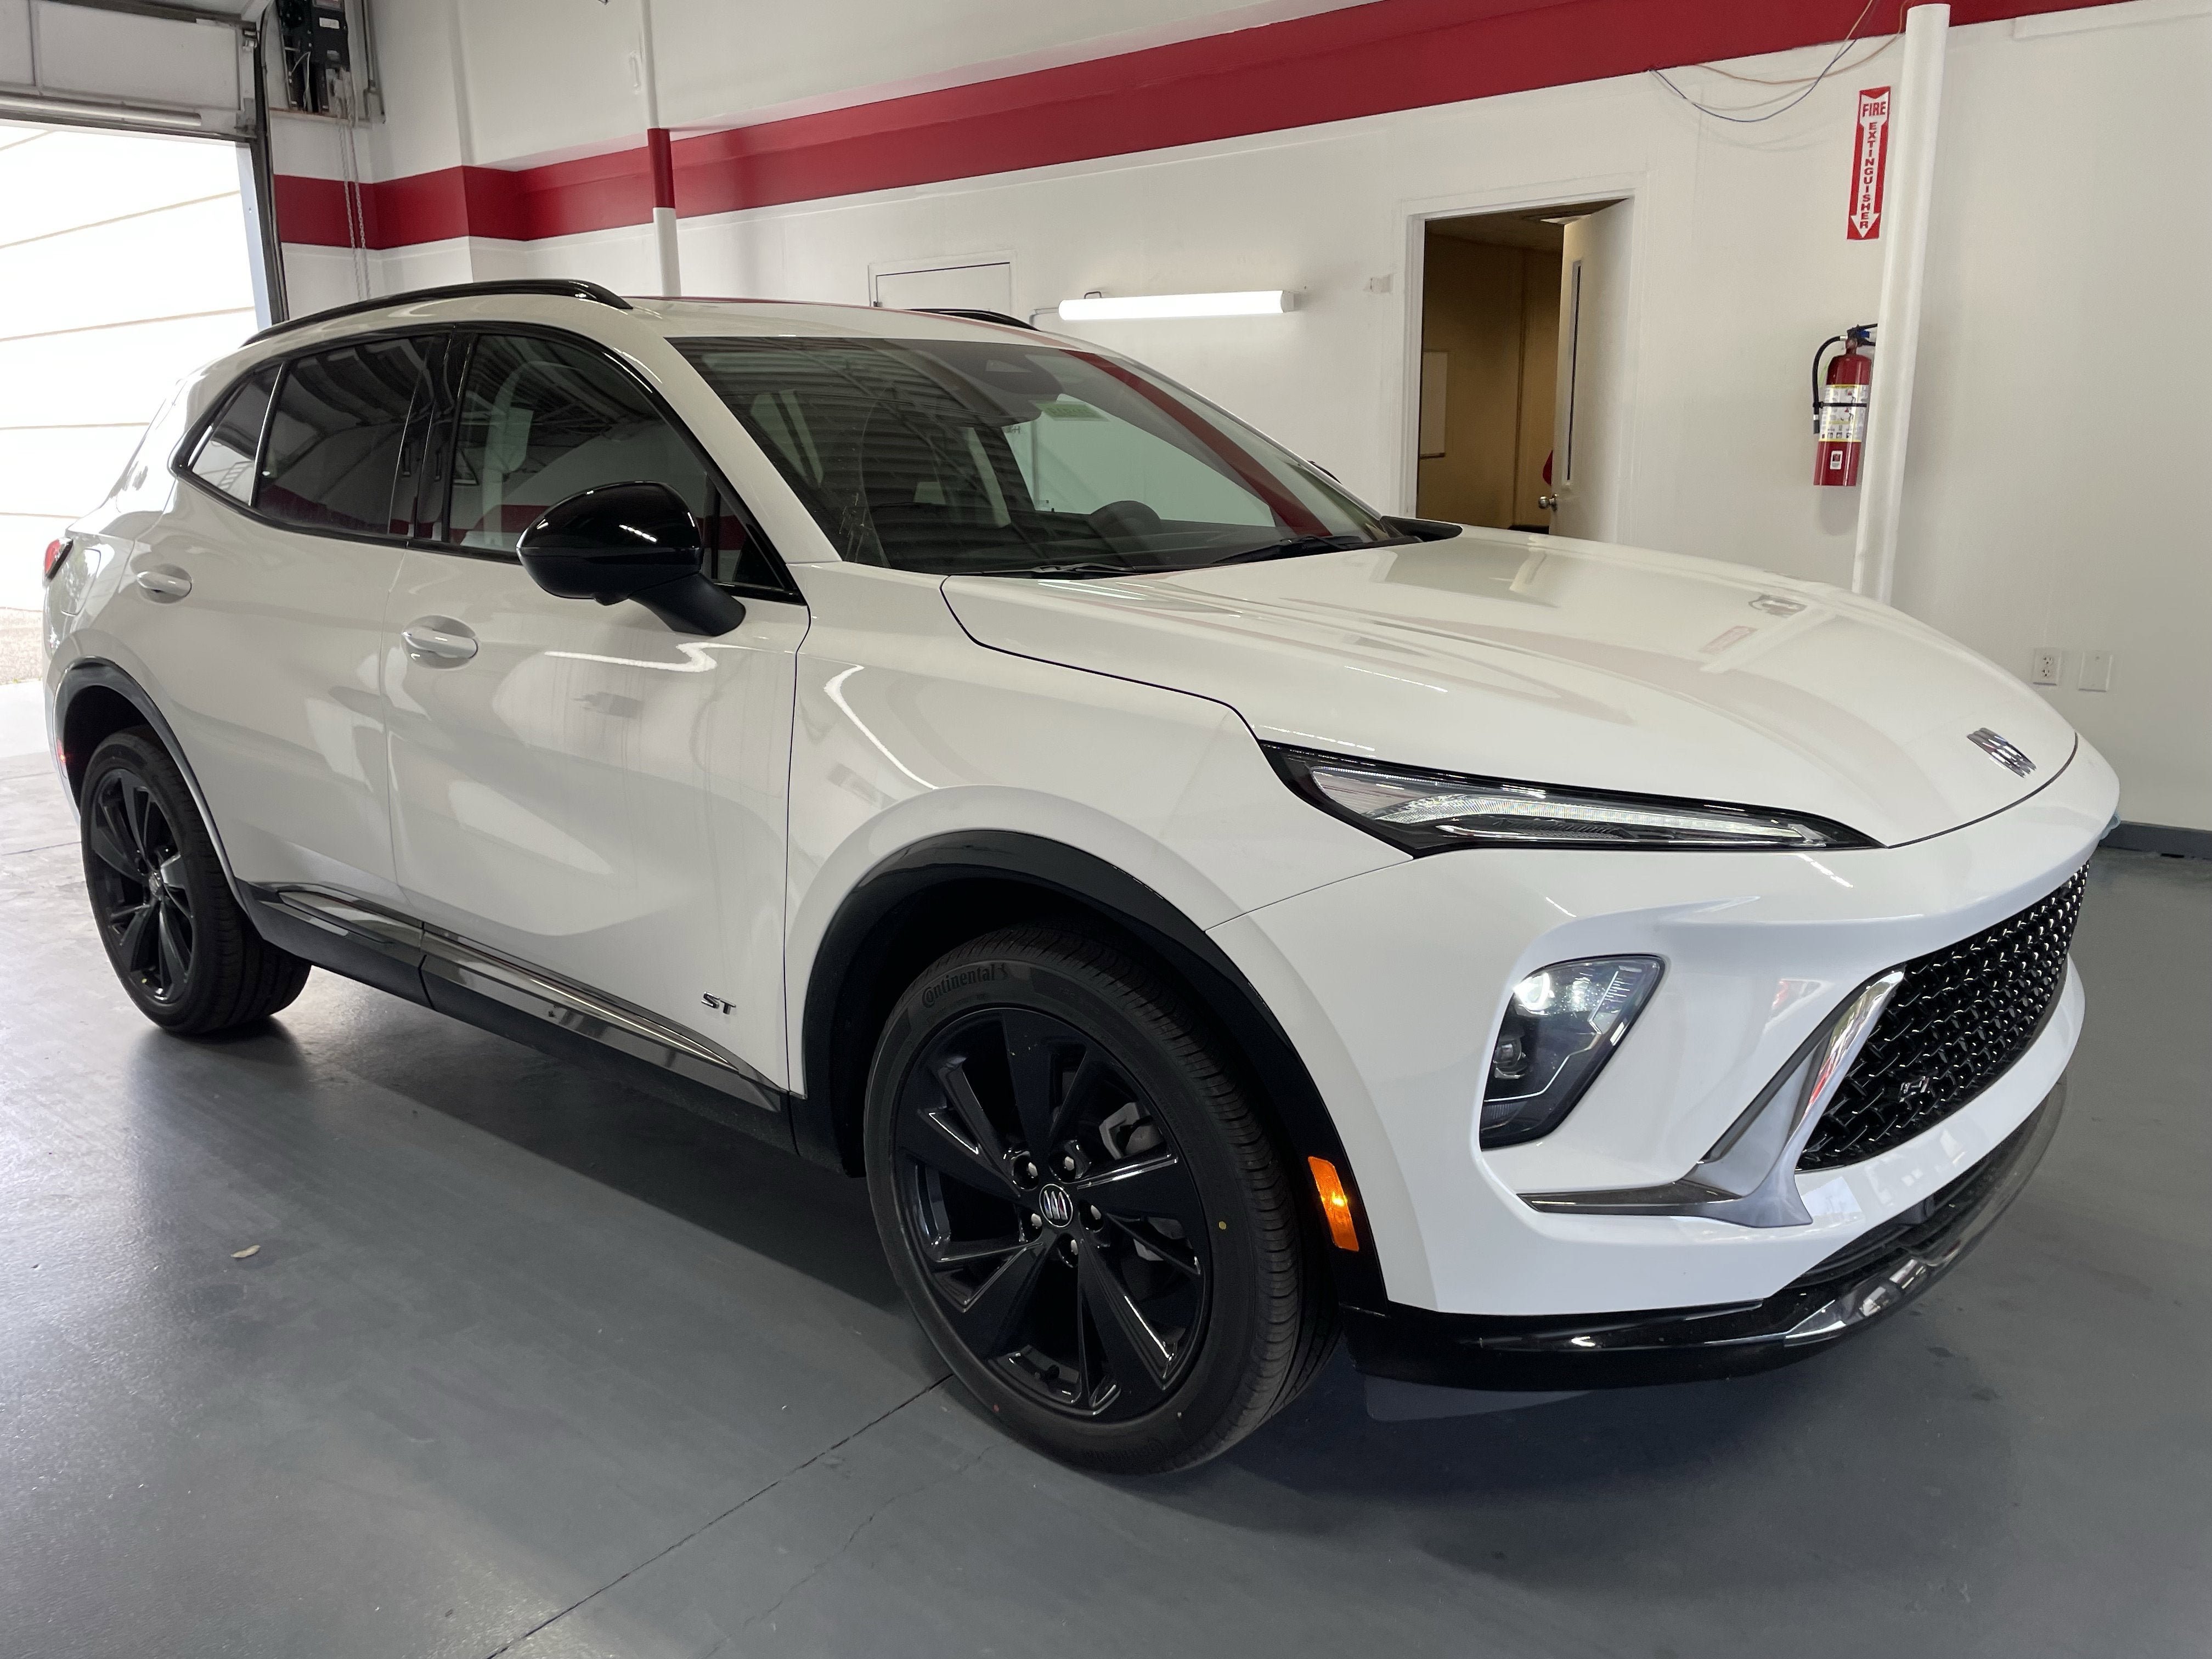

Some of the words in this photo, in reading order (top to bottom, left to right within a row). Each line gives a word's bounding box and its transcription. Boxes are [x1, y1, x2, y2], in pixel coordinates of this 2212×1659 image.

[1862, 101, 1887, 117] FIRE
[1860, 122, 1877, 229] EXTINGUISHER
[701, 991, 736, 1015] ST
[922, 964, 995, 1008] Continental
